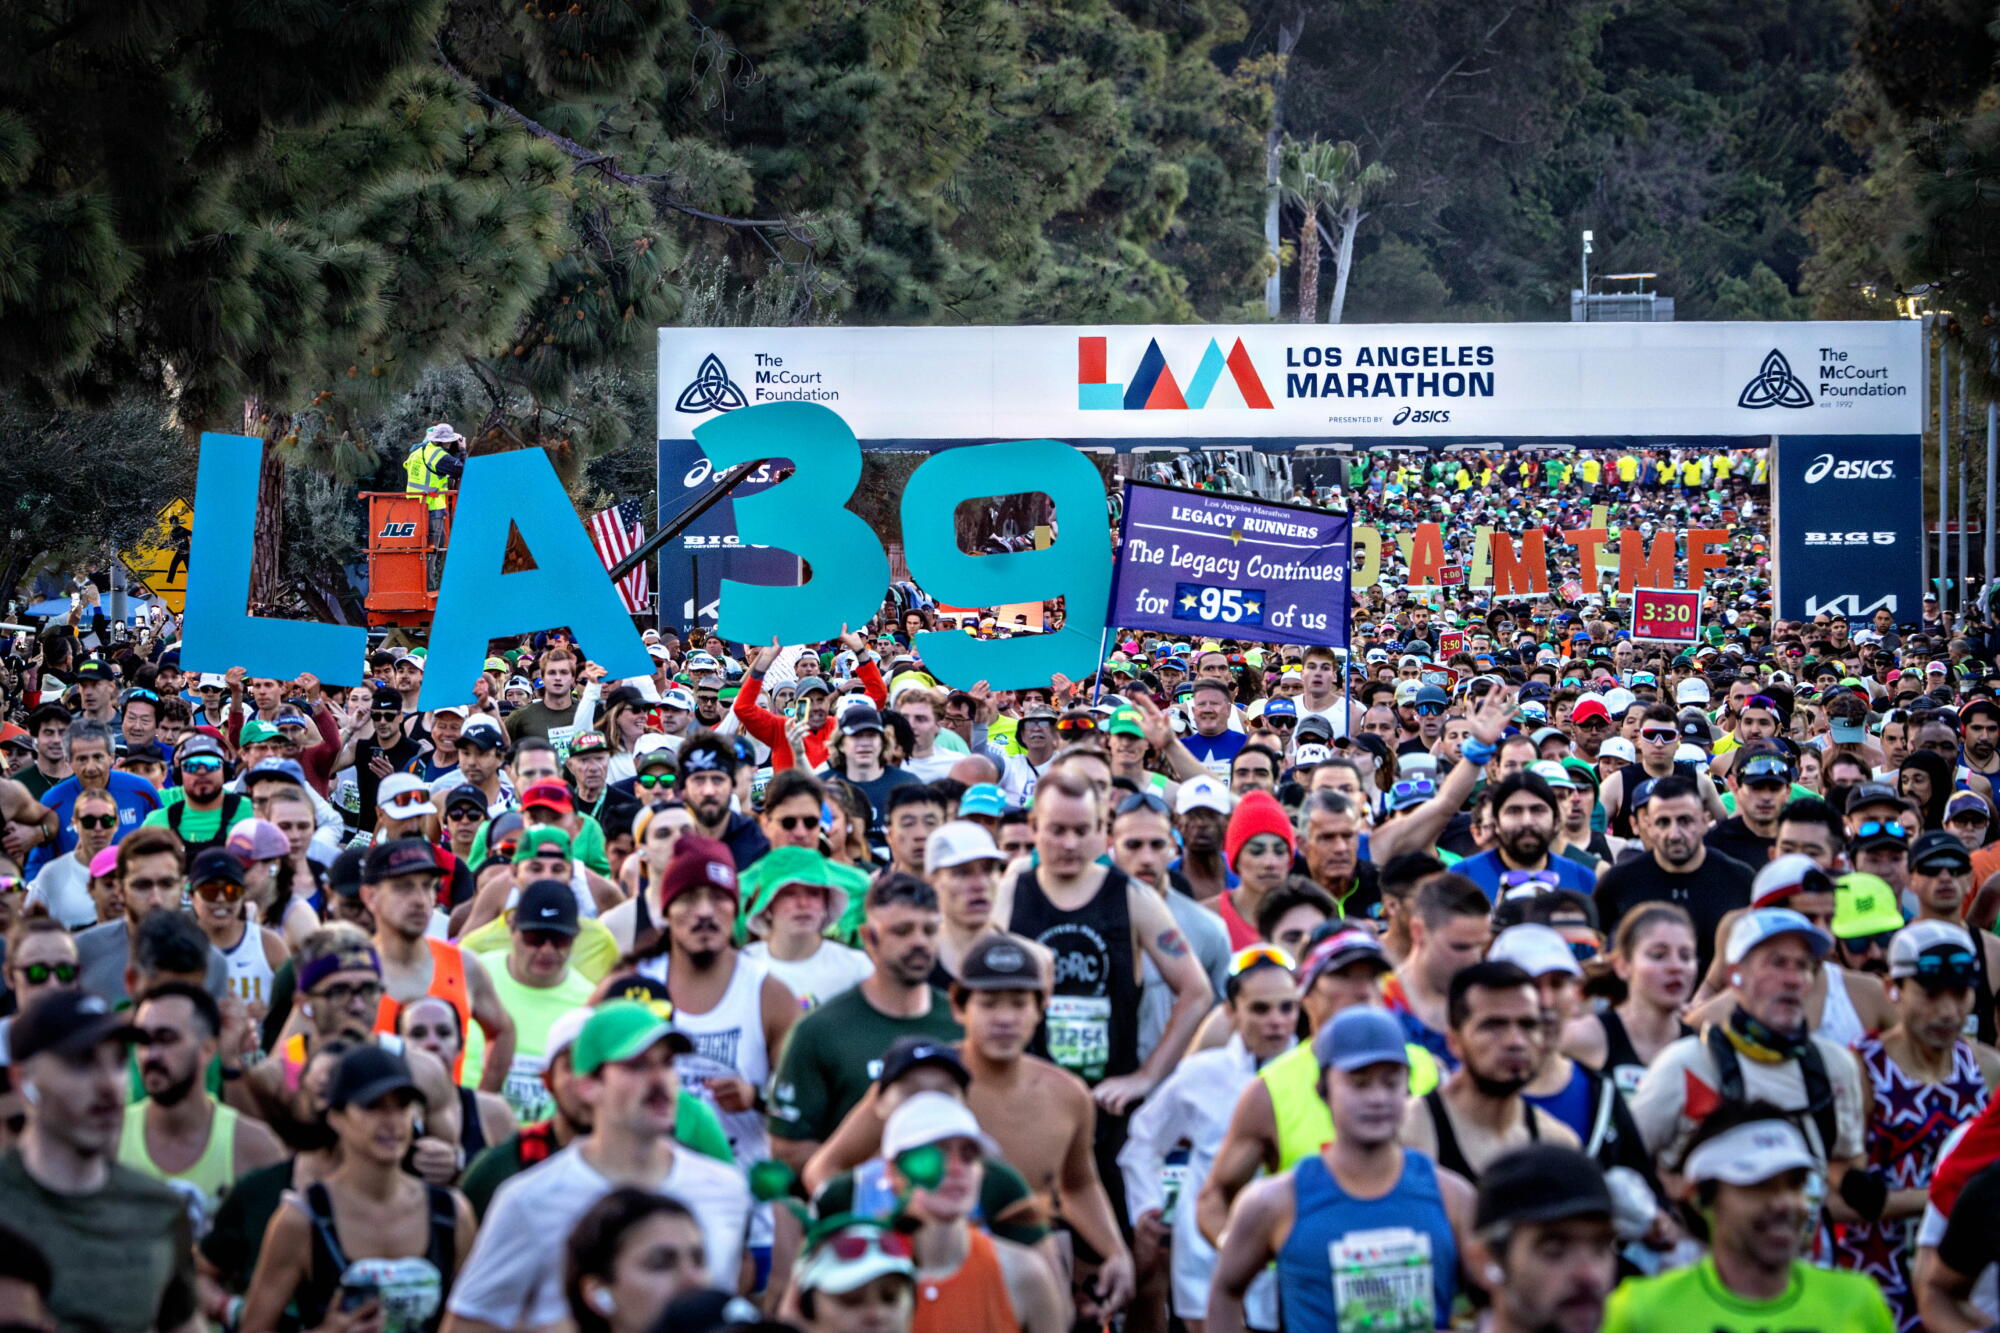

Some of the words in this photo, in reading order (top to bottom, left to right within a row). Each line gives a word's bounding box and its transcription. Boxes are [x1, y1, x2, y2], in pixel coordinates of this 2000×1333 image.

[755, 353, 783, 367] The
[1286, 346, 1342, 367] LOS
[1355, 345, 1495, 367] ANGELES
[1819, 348, 1848, 362] The
[755, 370, 822, 384] McCourt
[1820, 365, 1888, 379] McCourt
[1286, 372, 1496, 398] MARATHON
[1820, 382, 1906, 396] Foundation
[755, 387, 839, 401] Foundation
[1328, 415, 1372, 424] PRESENTED
[1373, 415, 1383, 423] BY
[1204, 499, 1219, 509] Los
[1220, 501, 1252, 514] Angeles
[1253, 507, 1291, 519] Marathon
[378, 522, 417, 537] JLG
[1171, 506, 1237, 528] LEGACY
[1243, 516, 1319, 539] RUNNERS
[684, 535, 740, 545] BIG
[1804, 531, 1869, 541] BIG
[1872, 531, 1897, 545] 5
[1129, 539, 1165, 564] The
[1170, 544, 1240, 581] Legacy
[1247, 555, 1343, 582] Continues
[1135, 588, 1169, 614] for
[1199, 587, 1243, 622] 95
[1271, 604, 1297, 628] of
[1301, 613, 1327, 629] us
[1642, 602, 1691, 623] 3:30
[1442, 640, 1460, 651] 3:50
